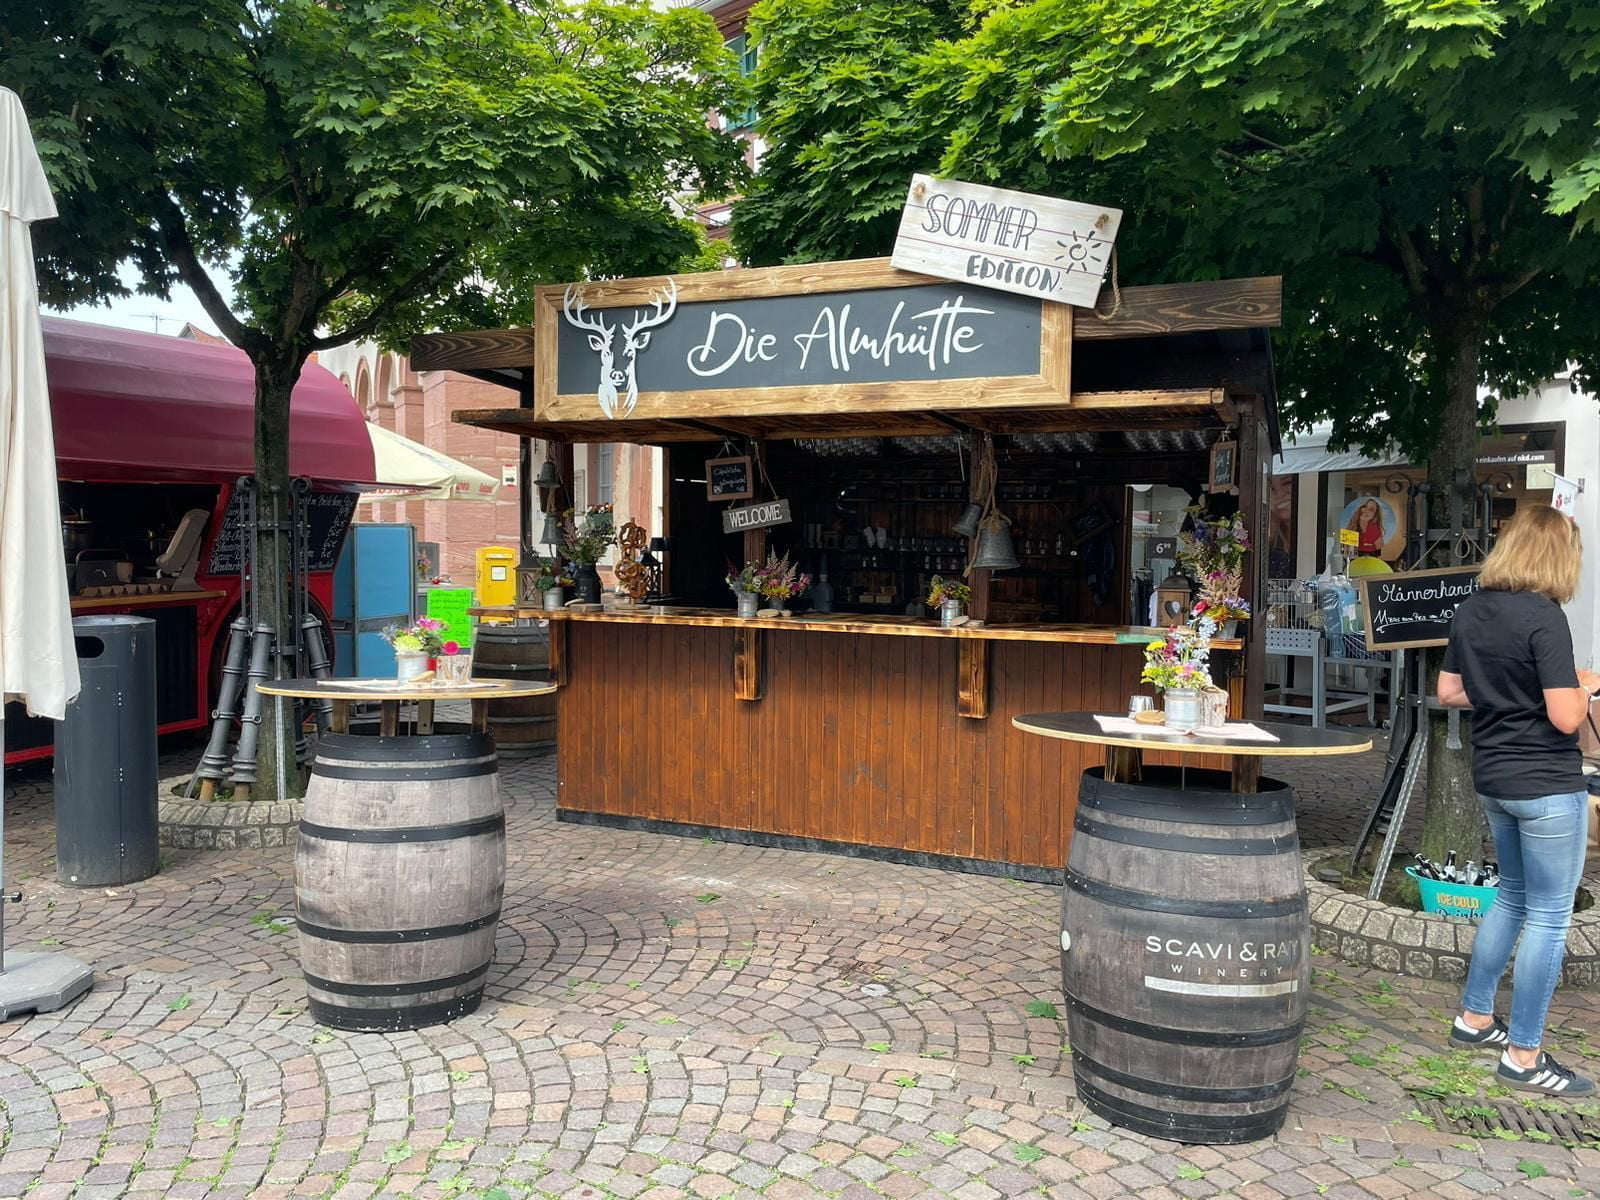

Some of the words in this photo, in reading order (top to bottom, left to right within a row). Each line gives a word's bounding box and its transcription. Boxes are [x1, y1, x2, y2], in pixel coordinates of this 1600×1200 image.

[921, 194, 1037, 251] SOMMER
[687, 311, 778, 376] Die
[794, 295, 995, 372] Almhütte
[728, 503, 783, 528] WELCOME
[1145, 935, 1232, 960] SCAVI
[1239, 942, 1257, 961] &
[1263, 940, 1298, 960] RAY
[1171, 964, 1282, 978] WINERY
